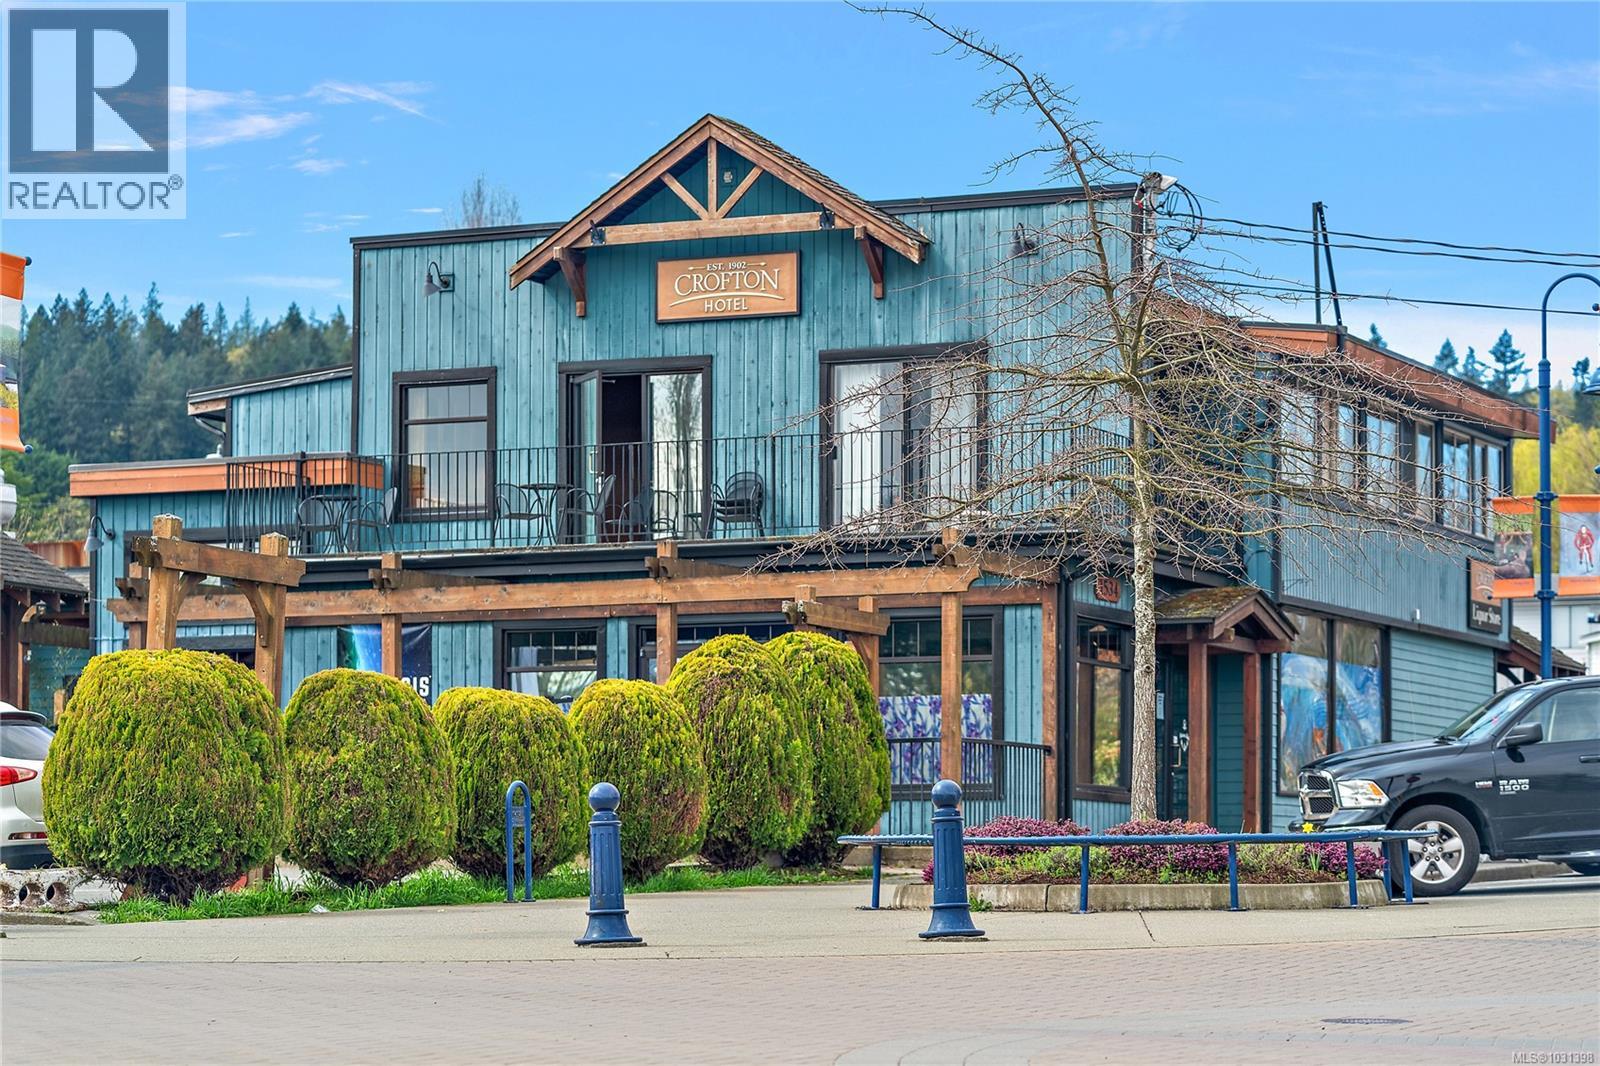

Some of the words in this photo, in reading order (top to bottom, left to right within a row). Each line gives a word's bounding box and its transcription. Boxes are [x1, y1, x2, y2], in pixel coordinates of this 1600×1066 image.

[706, 263, 725, 271] EST.
[728, 261, 747, 270] 1902
[674, 268, 780, 296] CROFTON
[704, 298, 748, 312] HOTEL
